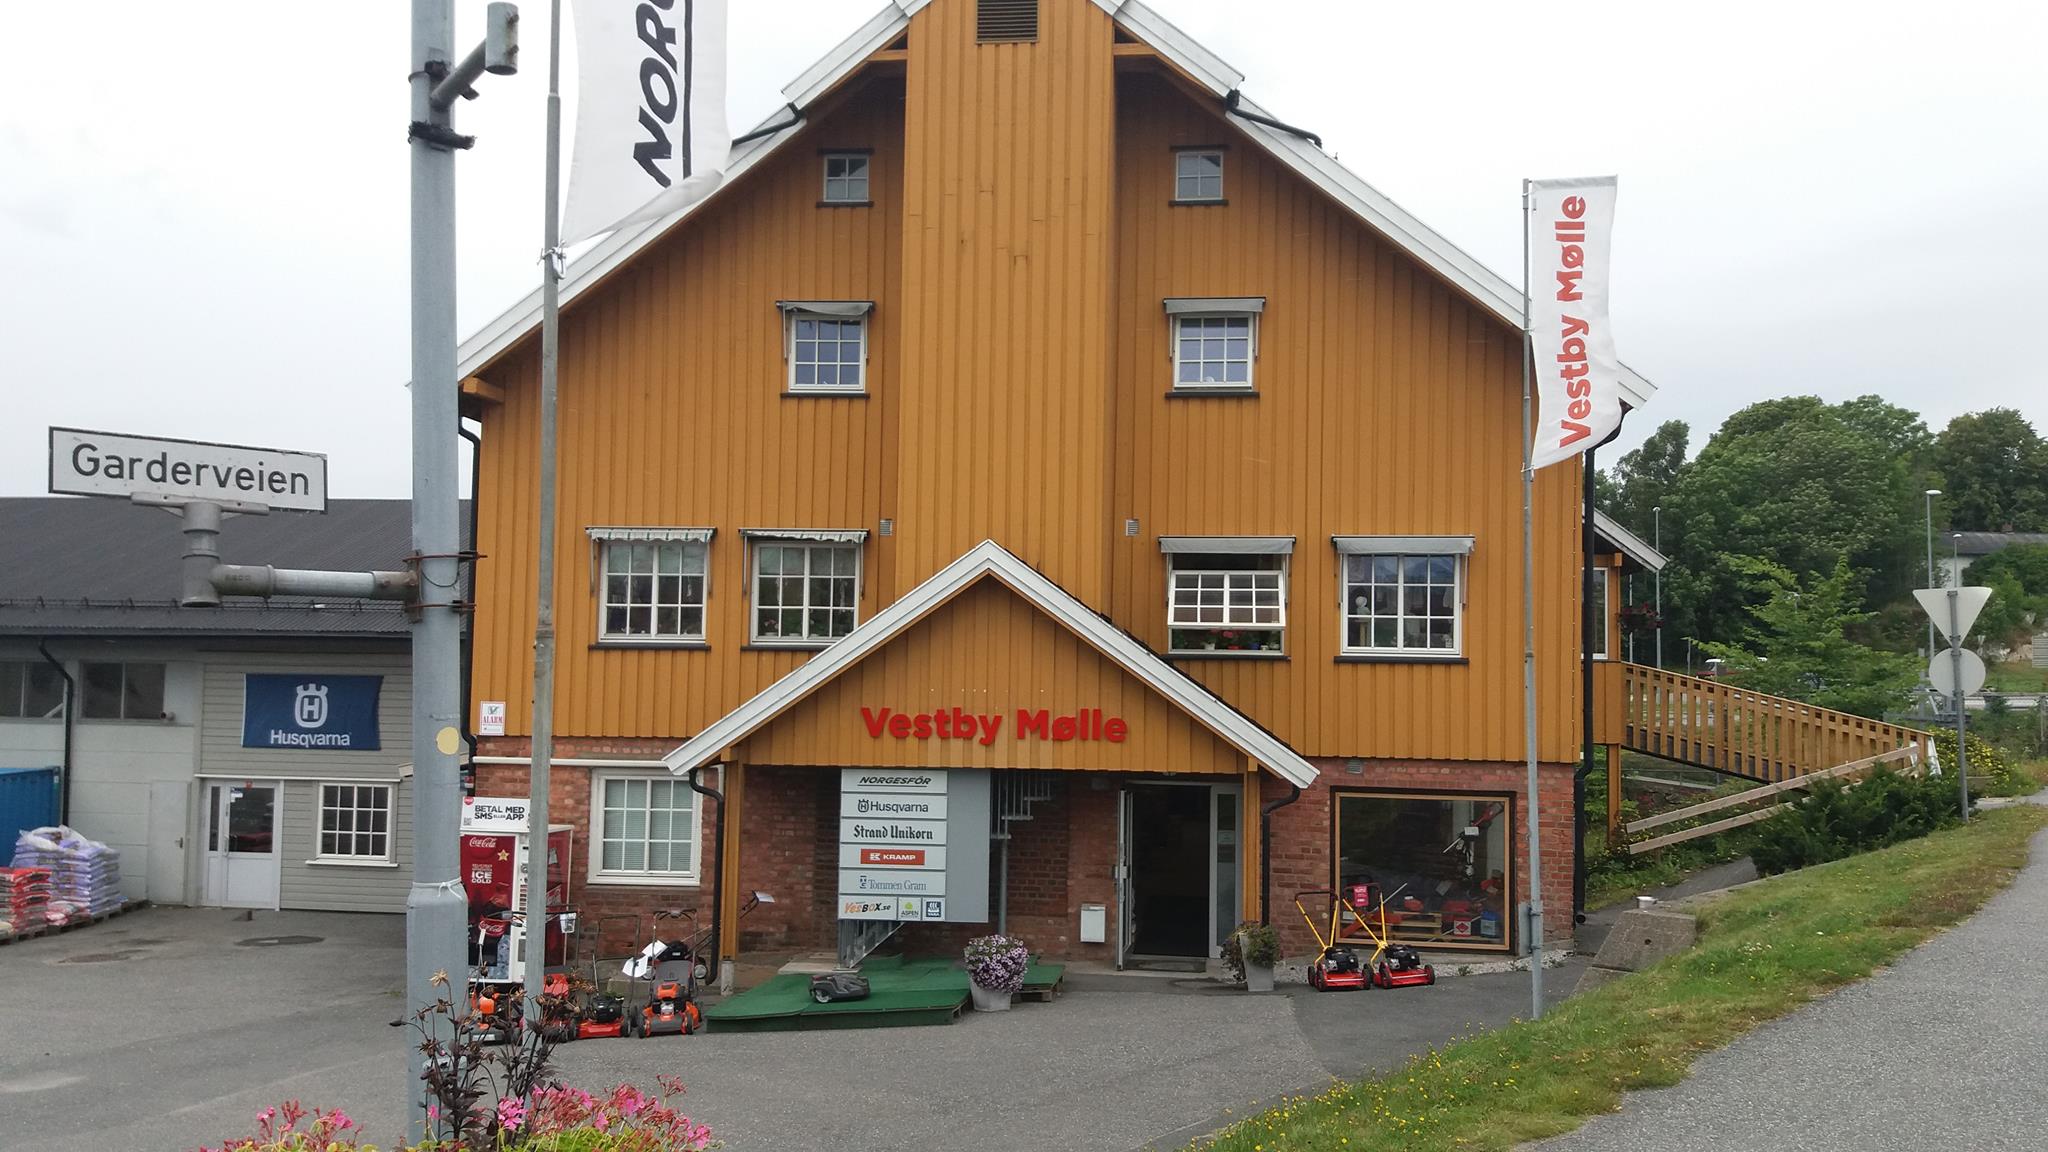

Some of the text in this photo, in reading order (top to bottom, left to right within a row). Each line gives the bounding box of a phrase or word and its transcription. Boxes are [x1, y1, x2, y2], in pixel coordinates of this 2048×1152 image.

[633, 0, 678, 189] NOR
[1554, 195, 1592, 449] Vestby Mølle
[71, 442, 310, 496] Garderveien
[860, 706, 1129, 746] Vestby Mølle
[270, 729, 351, 748] Husqvarna
[474, 805, 525, 814] BETAL MED
[870, 801, 929, 813] Husqvarna
[474, 812, 493, 820] SMS
[505, 813, 525, 821] APP
[853, 824, 933, 840] Strand Unikorn
[471, 871, 492, 879] ICE
[868, 880, 927, 891] Tommen Gram
